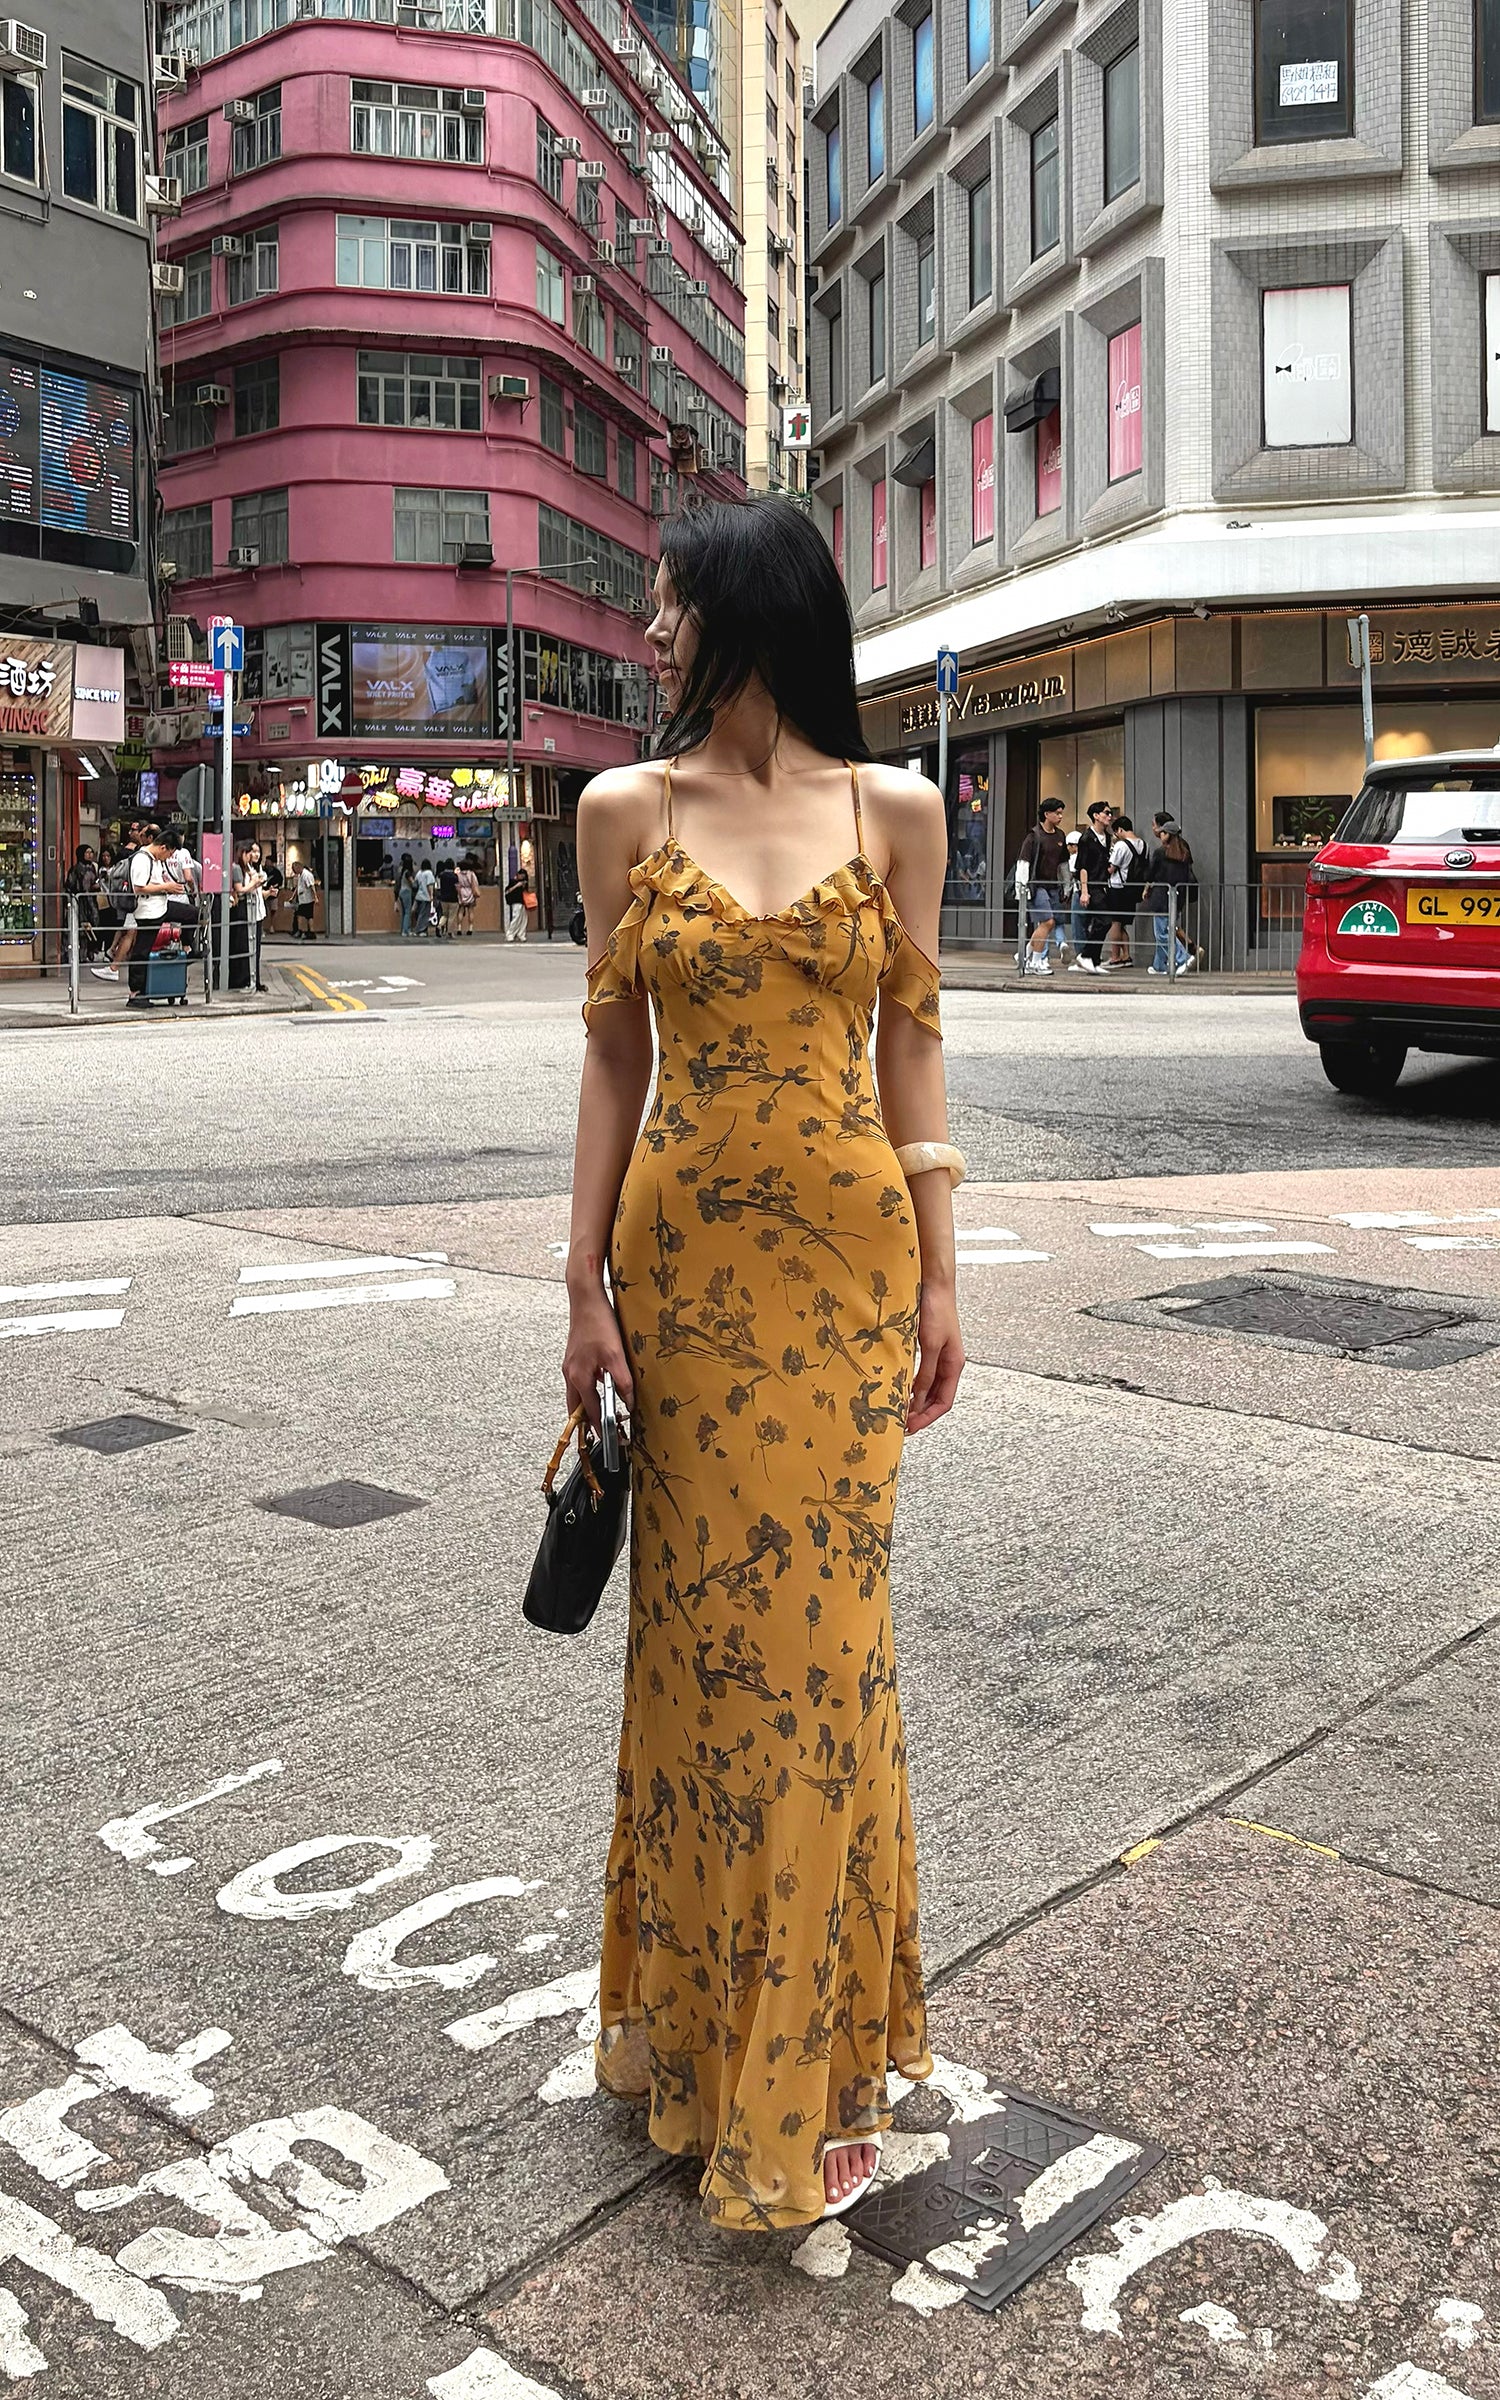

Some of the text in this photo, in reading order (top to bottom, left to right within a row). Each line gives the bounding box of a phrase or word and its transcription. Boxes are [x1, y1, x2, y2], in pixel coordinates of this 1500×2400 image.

[0, 657, 57, 698] 酒坊
[321, 634, 342, 733] VALX
[366, 680, 414, 691] VALX
[75, 686, 120, 703] SINCE 1917
[387, 691, 415, 699] PROTEIN
[395, 767, 455, 807] 豪華
[1358, 902, 1383, 912] TAXI
[1418, 897, 1448, 916] GL
[1363, 911, 1375, 925] 6
[1350, 925, 1386, 933] SEATS
